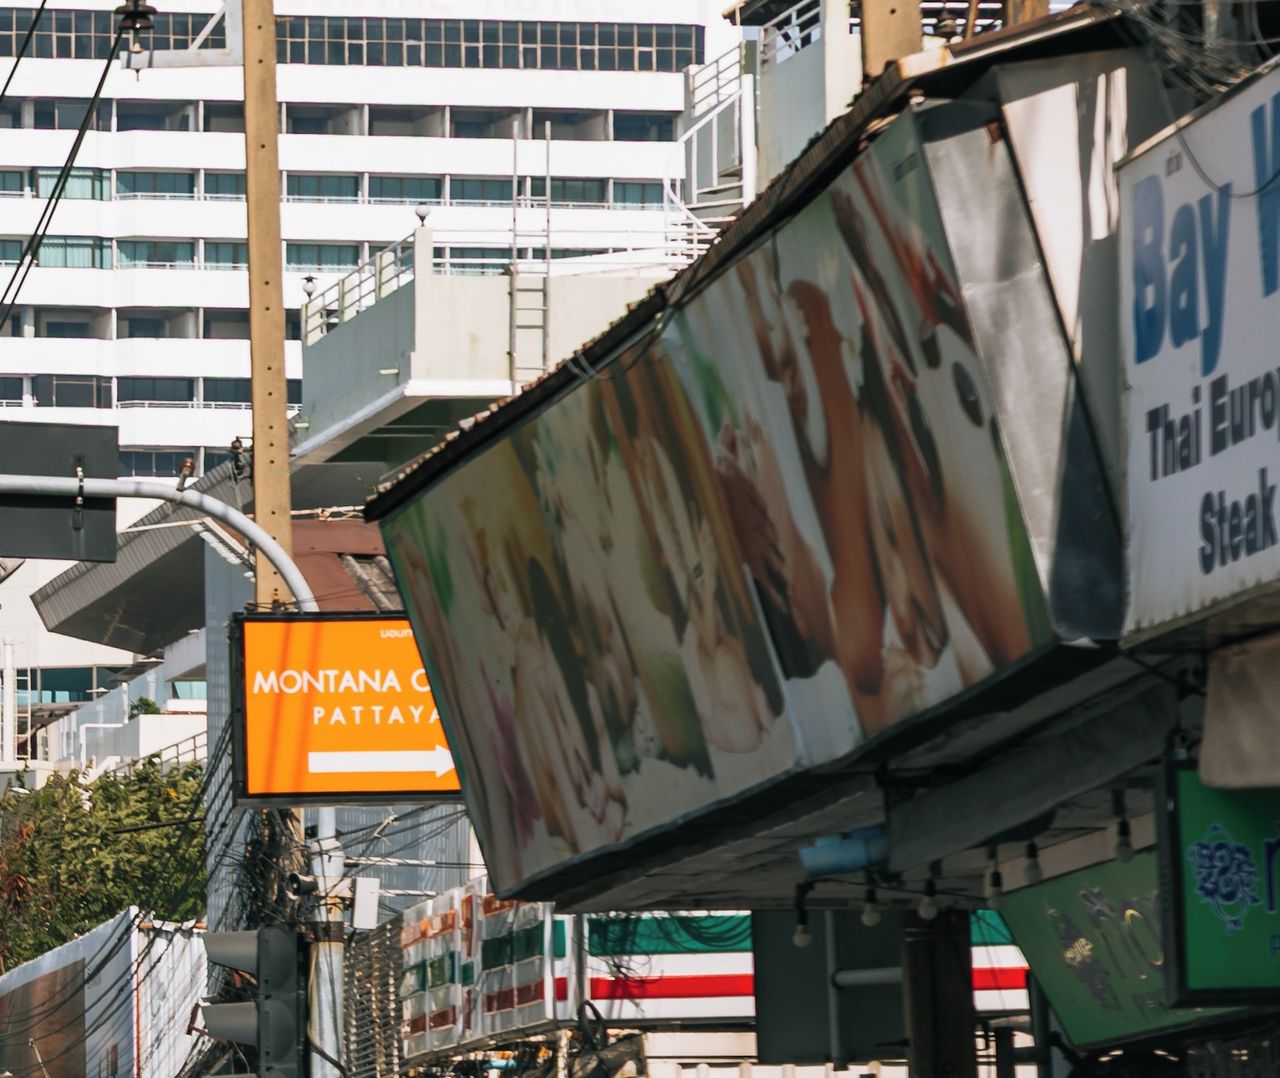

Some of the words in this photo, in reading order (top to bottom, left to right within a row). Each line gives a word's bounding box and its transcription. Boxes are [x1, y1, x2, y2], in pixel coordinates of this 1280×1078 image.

[1131, 175, 1233, 378] Bay
[1146, 386, 1203, 481] Thai
[1210, 367, 1280, 458] Euro
[1198, 468, 1278, 575] Steak
[252, 669, 402, 694] MONTANA
[313, 705, 442, 725] PATTAYA
